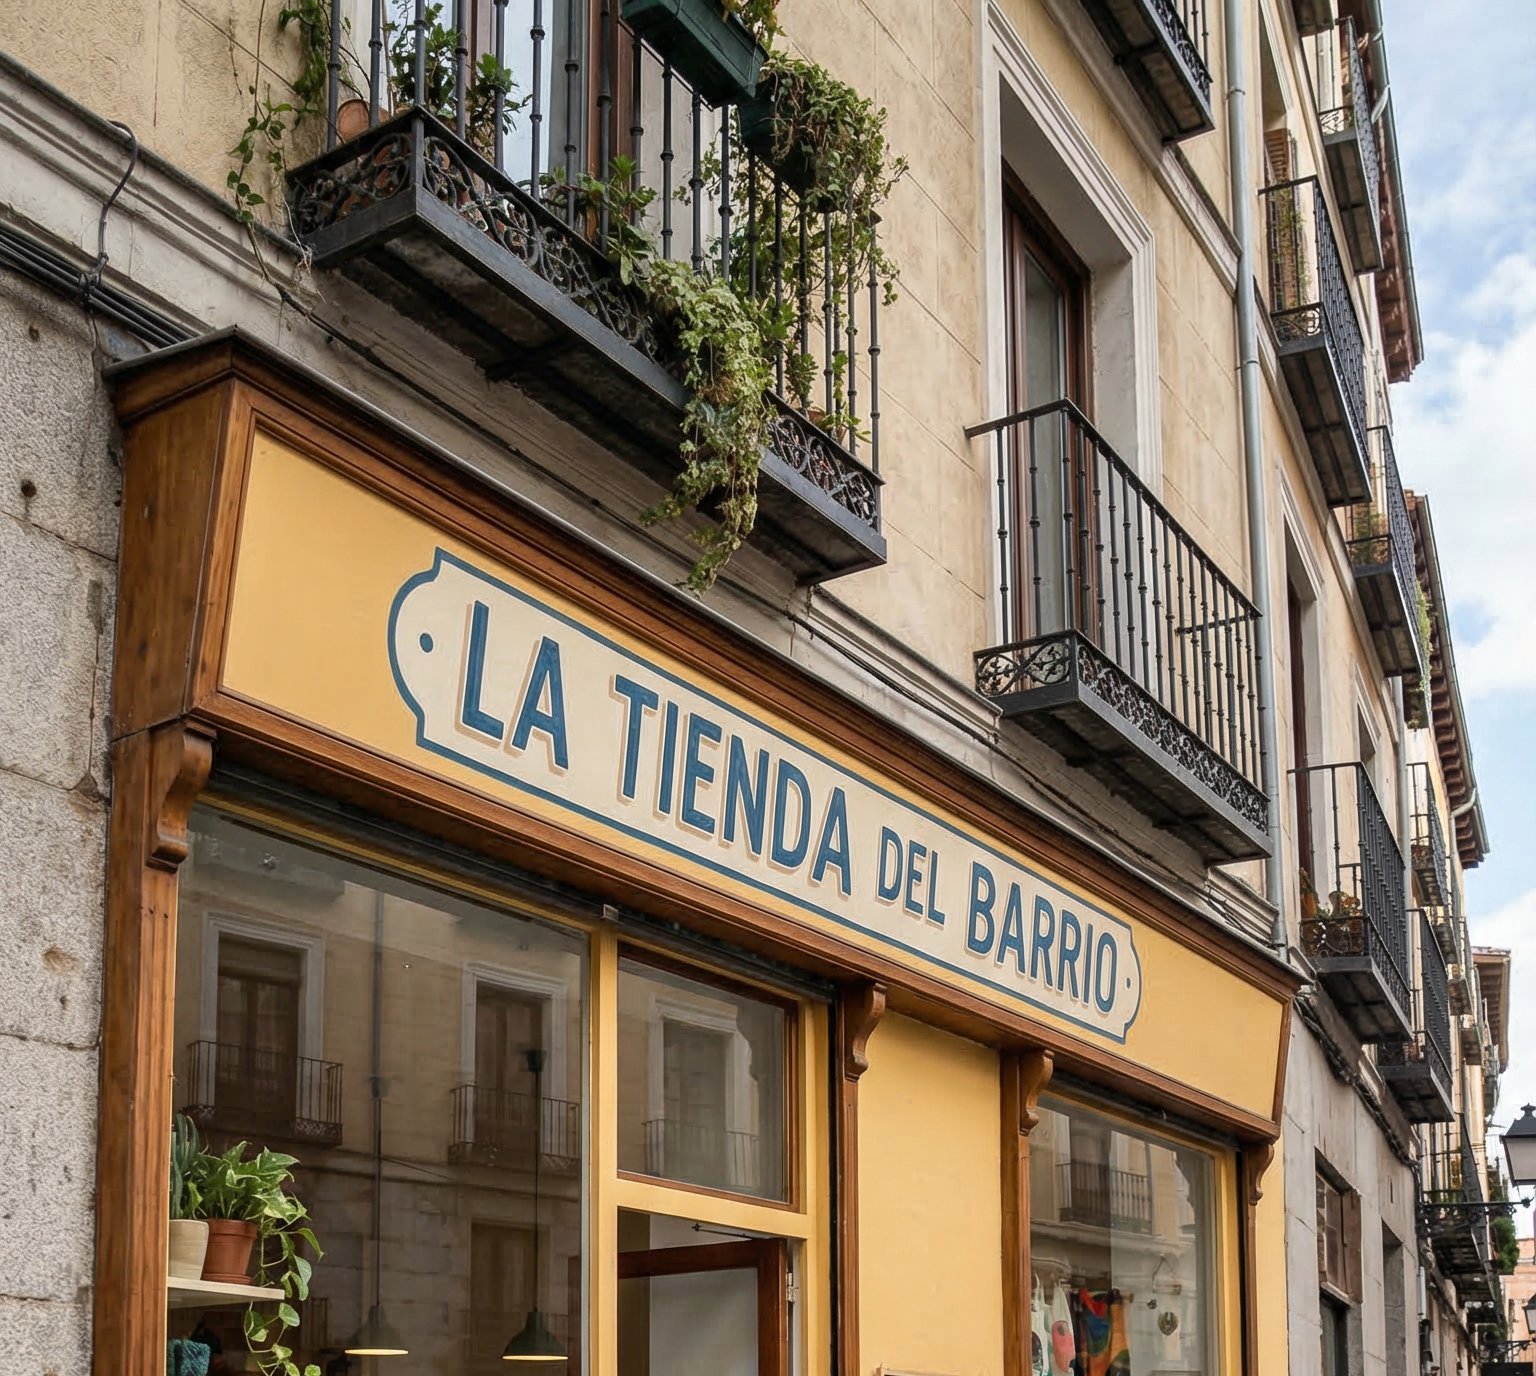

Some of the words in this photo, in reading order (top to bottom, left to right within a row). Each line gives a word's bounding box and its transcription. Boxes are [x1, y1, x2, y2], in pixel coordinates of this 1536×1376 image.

[460, 600, 569, 771] LA
[612, 673, 853, 897] TIENDA
[876, 825, 946, 926] DEL
[965, 860, 1119, 1014] BARRIO
